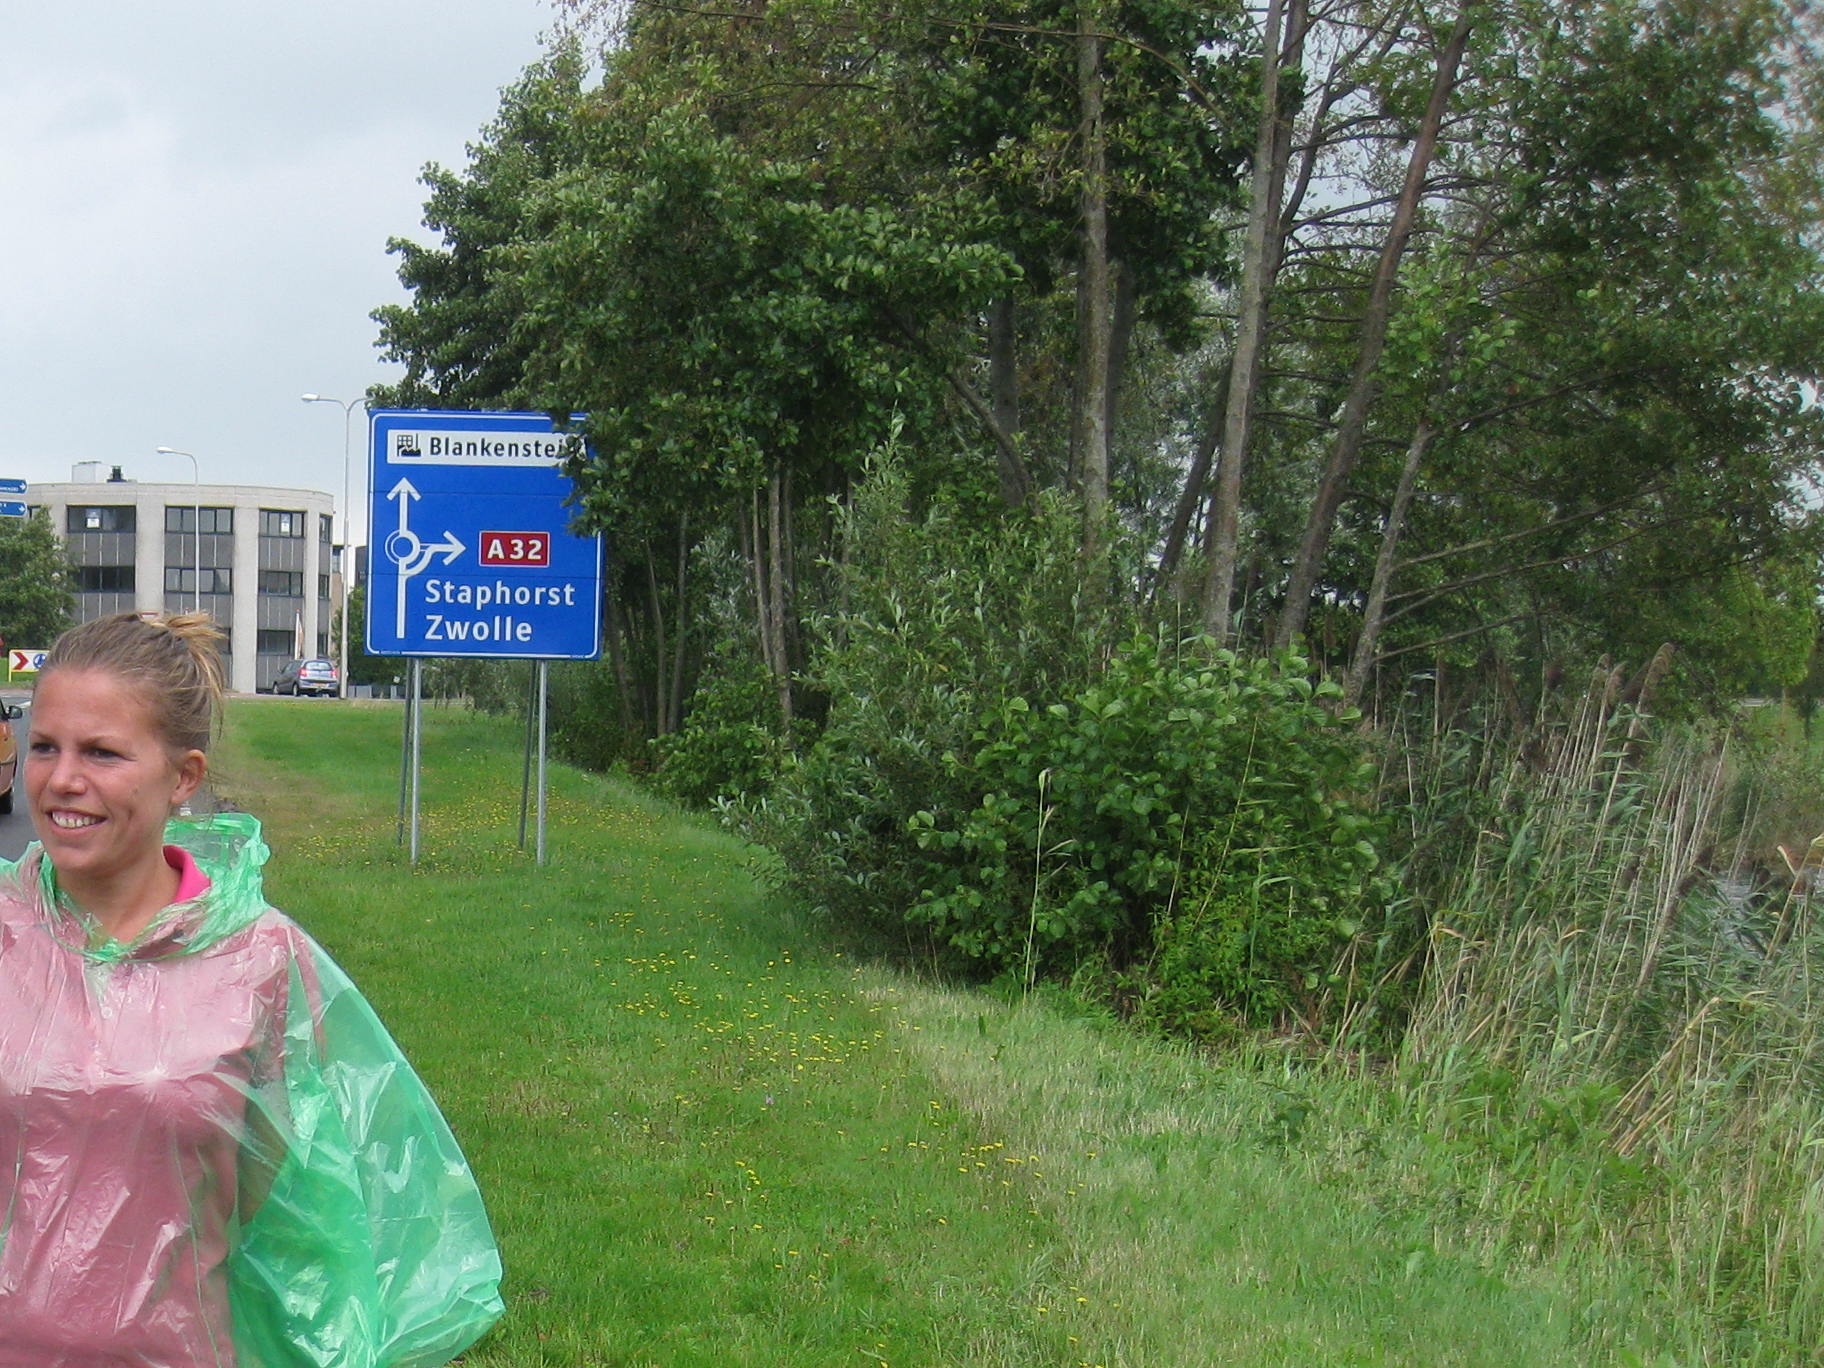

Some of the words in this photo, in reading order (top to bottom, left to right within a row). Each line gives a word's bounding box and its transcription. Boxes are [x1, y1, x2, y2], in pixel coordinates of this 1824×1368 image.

[429, 436, 578, 458] Blankenstei
[425, 579, 576, 610] Staphorst
[425, 615, 532, 642] Zwolle
